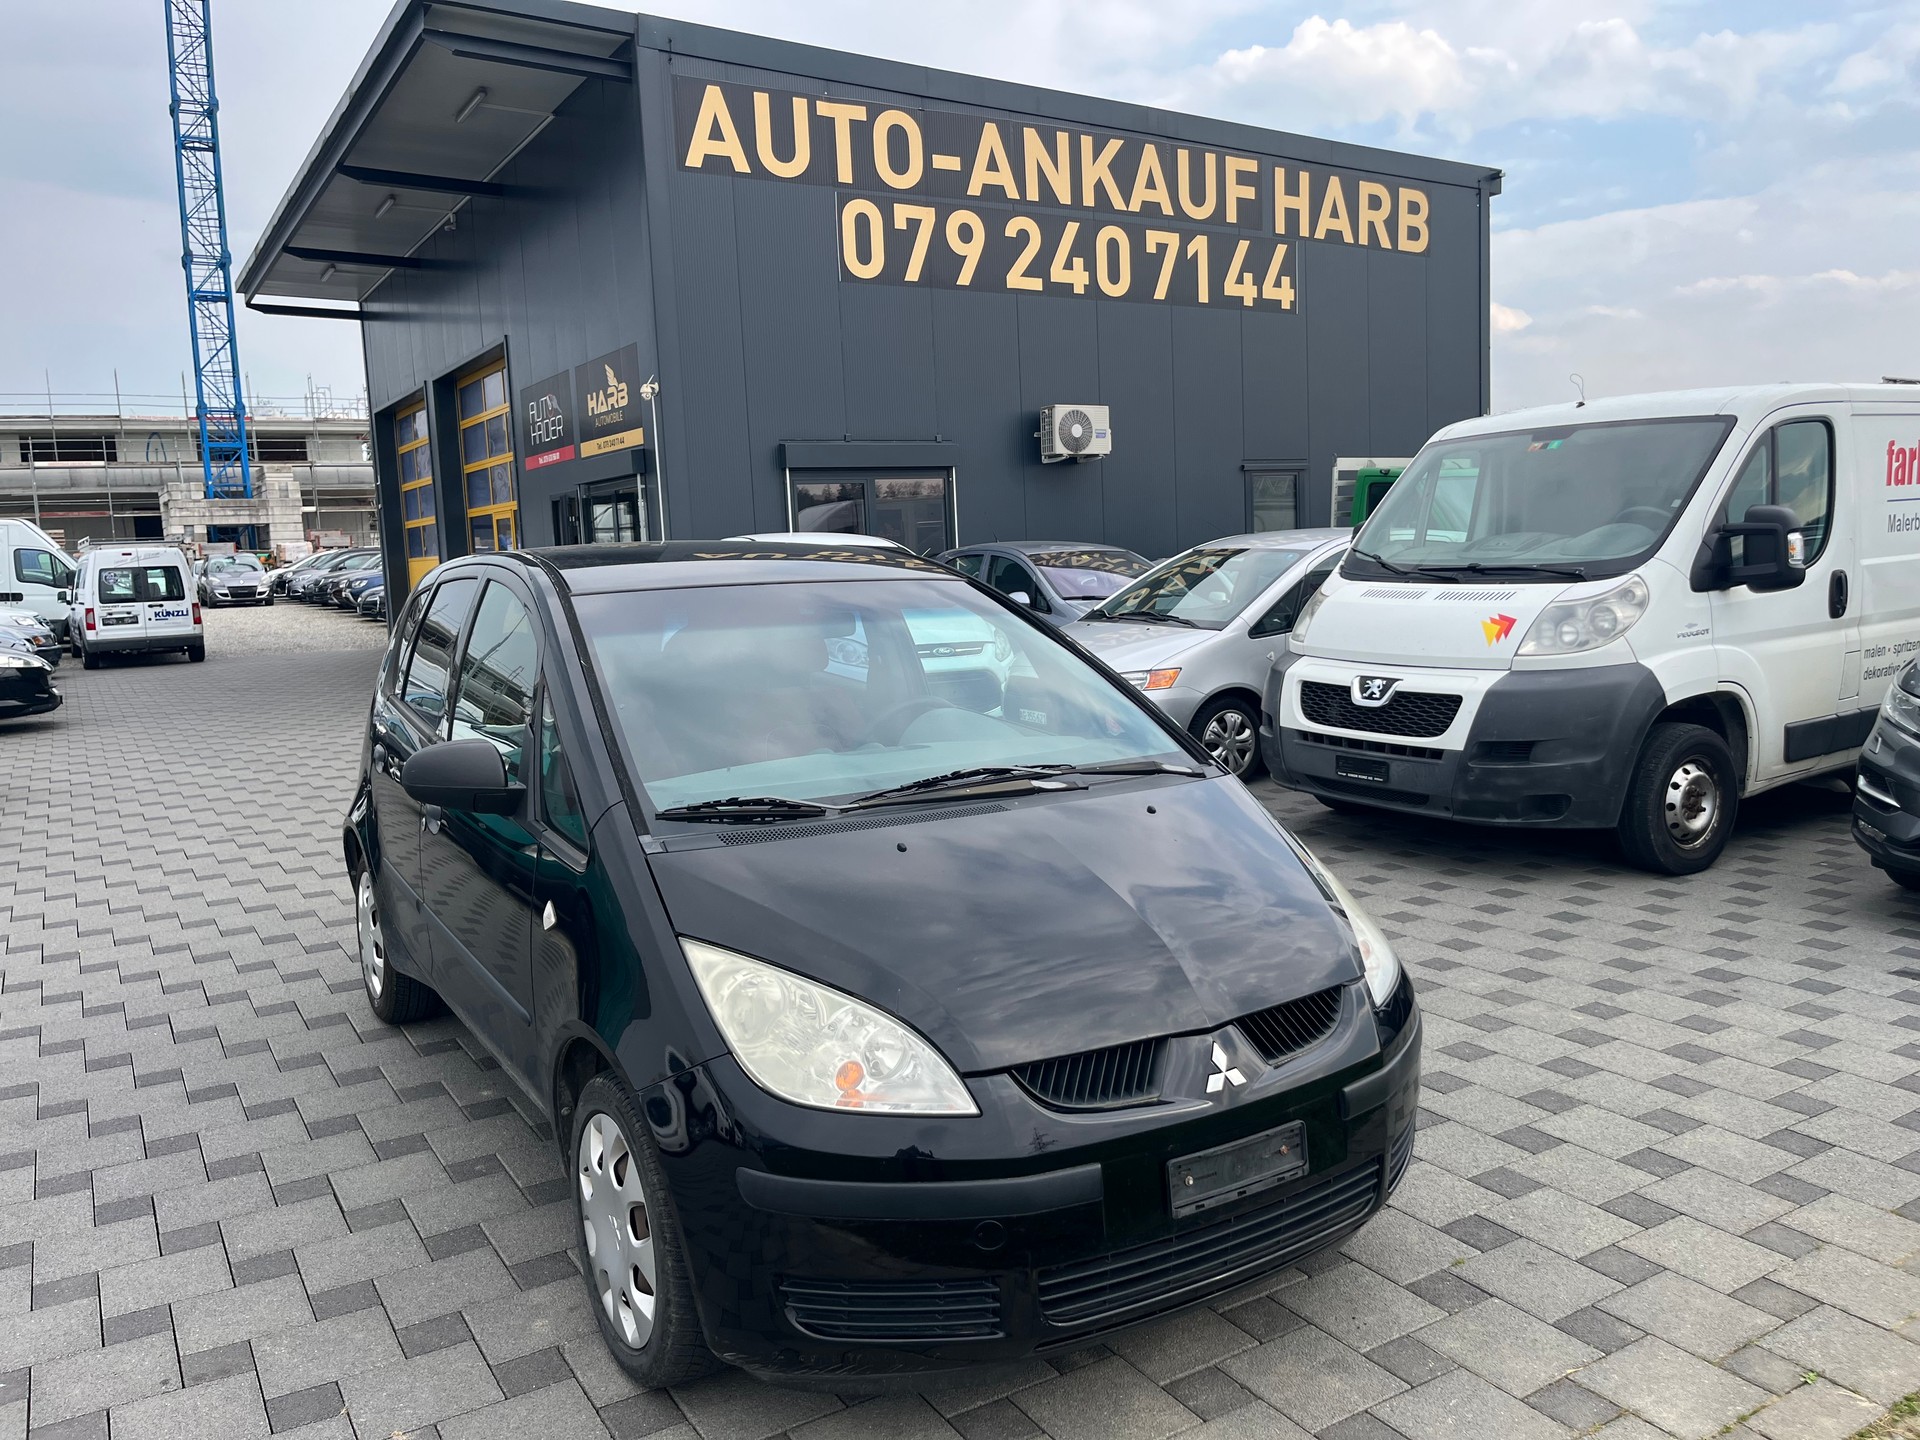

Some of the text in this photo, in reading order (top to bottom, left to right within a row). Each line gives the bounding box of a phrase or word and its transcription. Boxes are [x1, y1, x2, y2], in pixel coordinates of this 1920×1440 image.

[685, 84, 1430, 254] AUTO-ANKAUF HARB
[841, 198, 1296, 310] 079 240 71 44
[587, 382, 629, 416] HARB
[530, 414, 564, 446] HAIDER
[595, 410, 624, 428] AUTOMOBILE
[1676, 628, 1710, 639] PEUGEOT
[1863, 644, 1886, 659] malen
